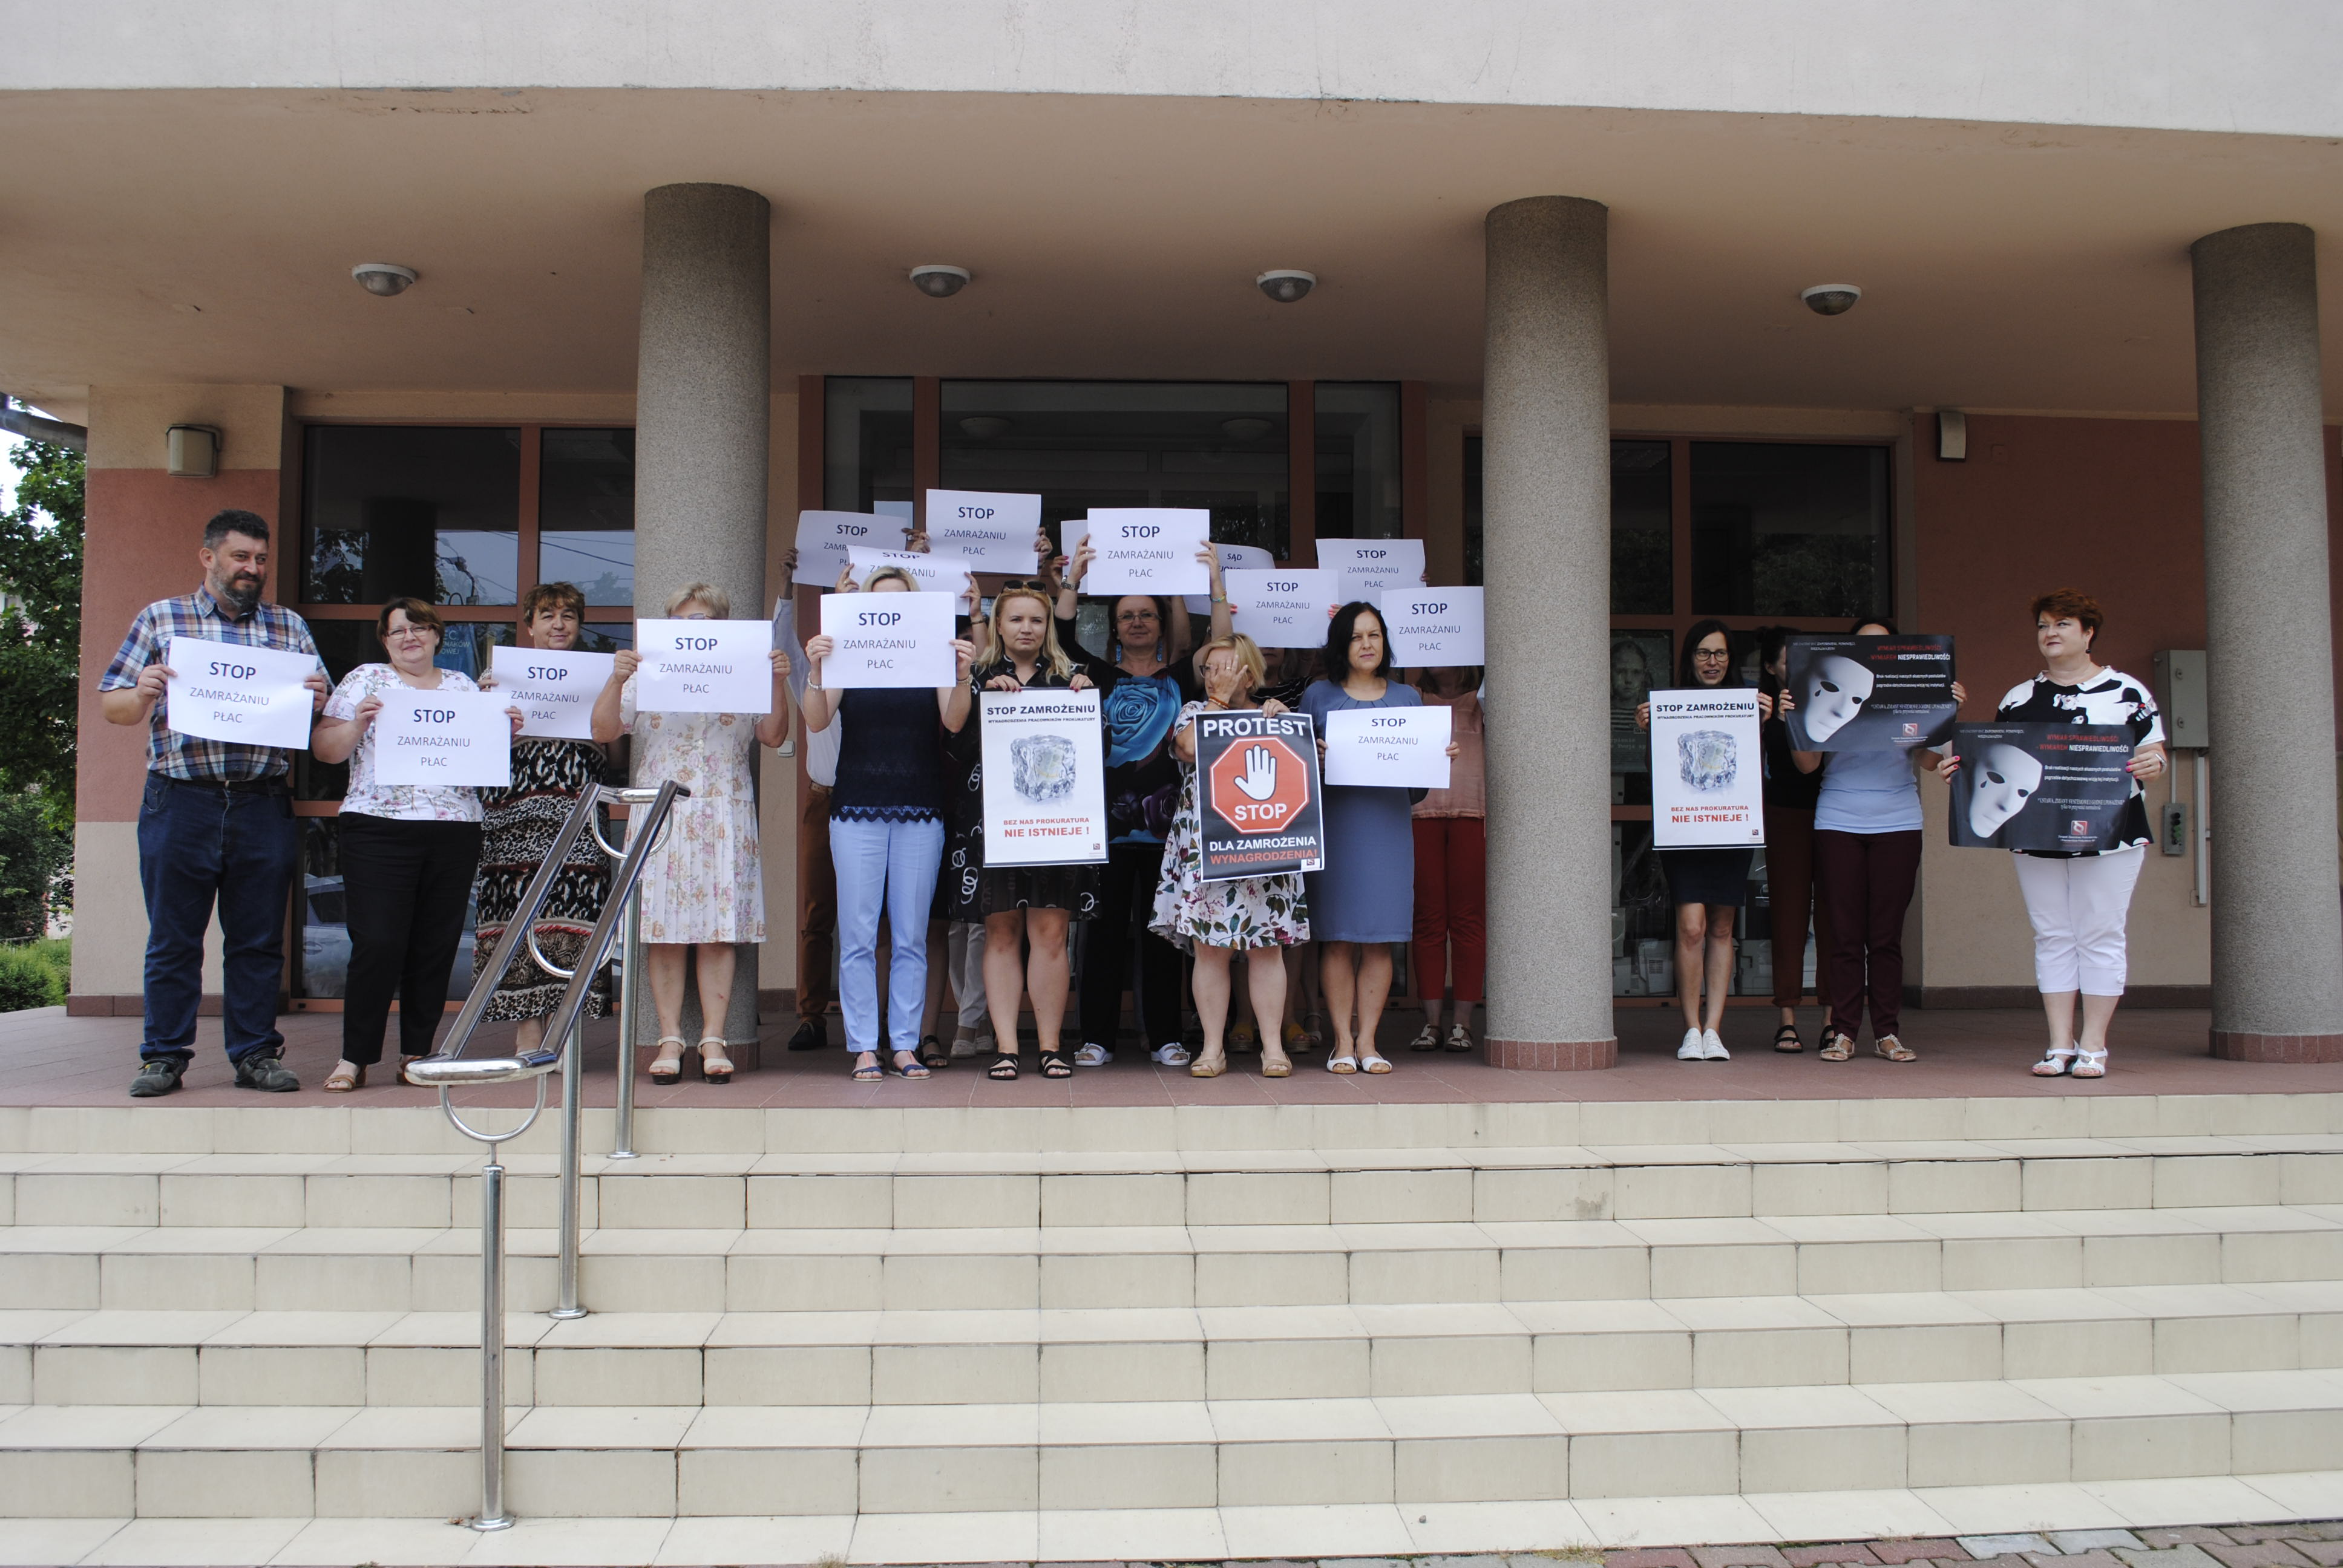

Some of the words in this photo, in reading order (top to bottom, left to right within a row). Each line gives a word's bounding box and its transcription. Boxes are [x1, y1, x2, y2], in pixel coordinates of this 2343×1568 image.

[958, 506, 995, 520] STOP
[836, 524, 868, 537] STOP
[944, 529, 1006, 540] ZAMRAŻANIU
[1121, 526, 1160, 538] STOP
[963, 546, 986, 555] PŁAC
[1107, 549, 1173, 560] ZAMRAŻANIU
[1356, 550, 1387, 559] STOP
[1227, 553, 1242, 562] SĄD
[1129, 569, 1153, 578] PŁAC
[1348, 566, 1399, 574] ZAMRAŻANIU
[1267, 582, 1299, 592] STOP
[1256, 601, 1310, 610] ZAMRAŻANIU
[1411, 603, 1448, 615] STOP
[859, 612, 901, 626] STOP
[1398, 624, 1461, 635] ZAMRAŻANIU
[675, 637, 718, 651] STOP
[843, 638, 916, 649] ZAMRAŻANIU
[1419, 642, 1441, 651] PŁAC
[660, 662, 733, 675] ZAMRAŻANIU
[867, 659, 894, 668] PŁAC
[209, 661, 257, 680] STOP
[527, 666, 568, 681] STOP
[683, 684, 710, 693] PŁAC
[189, 687, 269, 706] ZAMRAŻANIU
[511, 690, 580, 703] ZAMRAŻANIU
[987, 707, 1017, 715] STOP
[1020, 704, 1095, 714] ZAMROŻENIU
[1686, 702, 1754, 711] ZAMROŻENIU
[213, 711, 243, 724] PŁAC
[413, 709, 456, 724] STOP
[531, 710, 556, 720] PŁAC
[1203, 717, 1306, 737] PROTEST
[1371, 718, 1406, 727] STOP
[397, 735, 470, 748] ZAMRAŻANIU
[1358, 736, 1418, 745] ZAMRAŻANIU
[421, 757, 447, 767] PŁAC
[1377, 752, 1399, 761] PŁAC
[1234, 803, 1287, 821] STOP
[1004, 829, 1024, 837] NIE
[1029, 828, 1082, 837] ISTNIEJE
[1210, 840, 1234, 852] DLA
[1237, 835, 1317, 850] ZAMROŻENIA
[1211, 849, 1317, 864] WYNAGRODZENIA!
